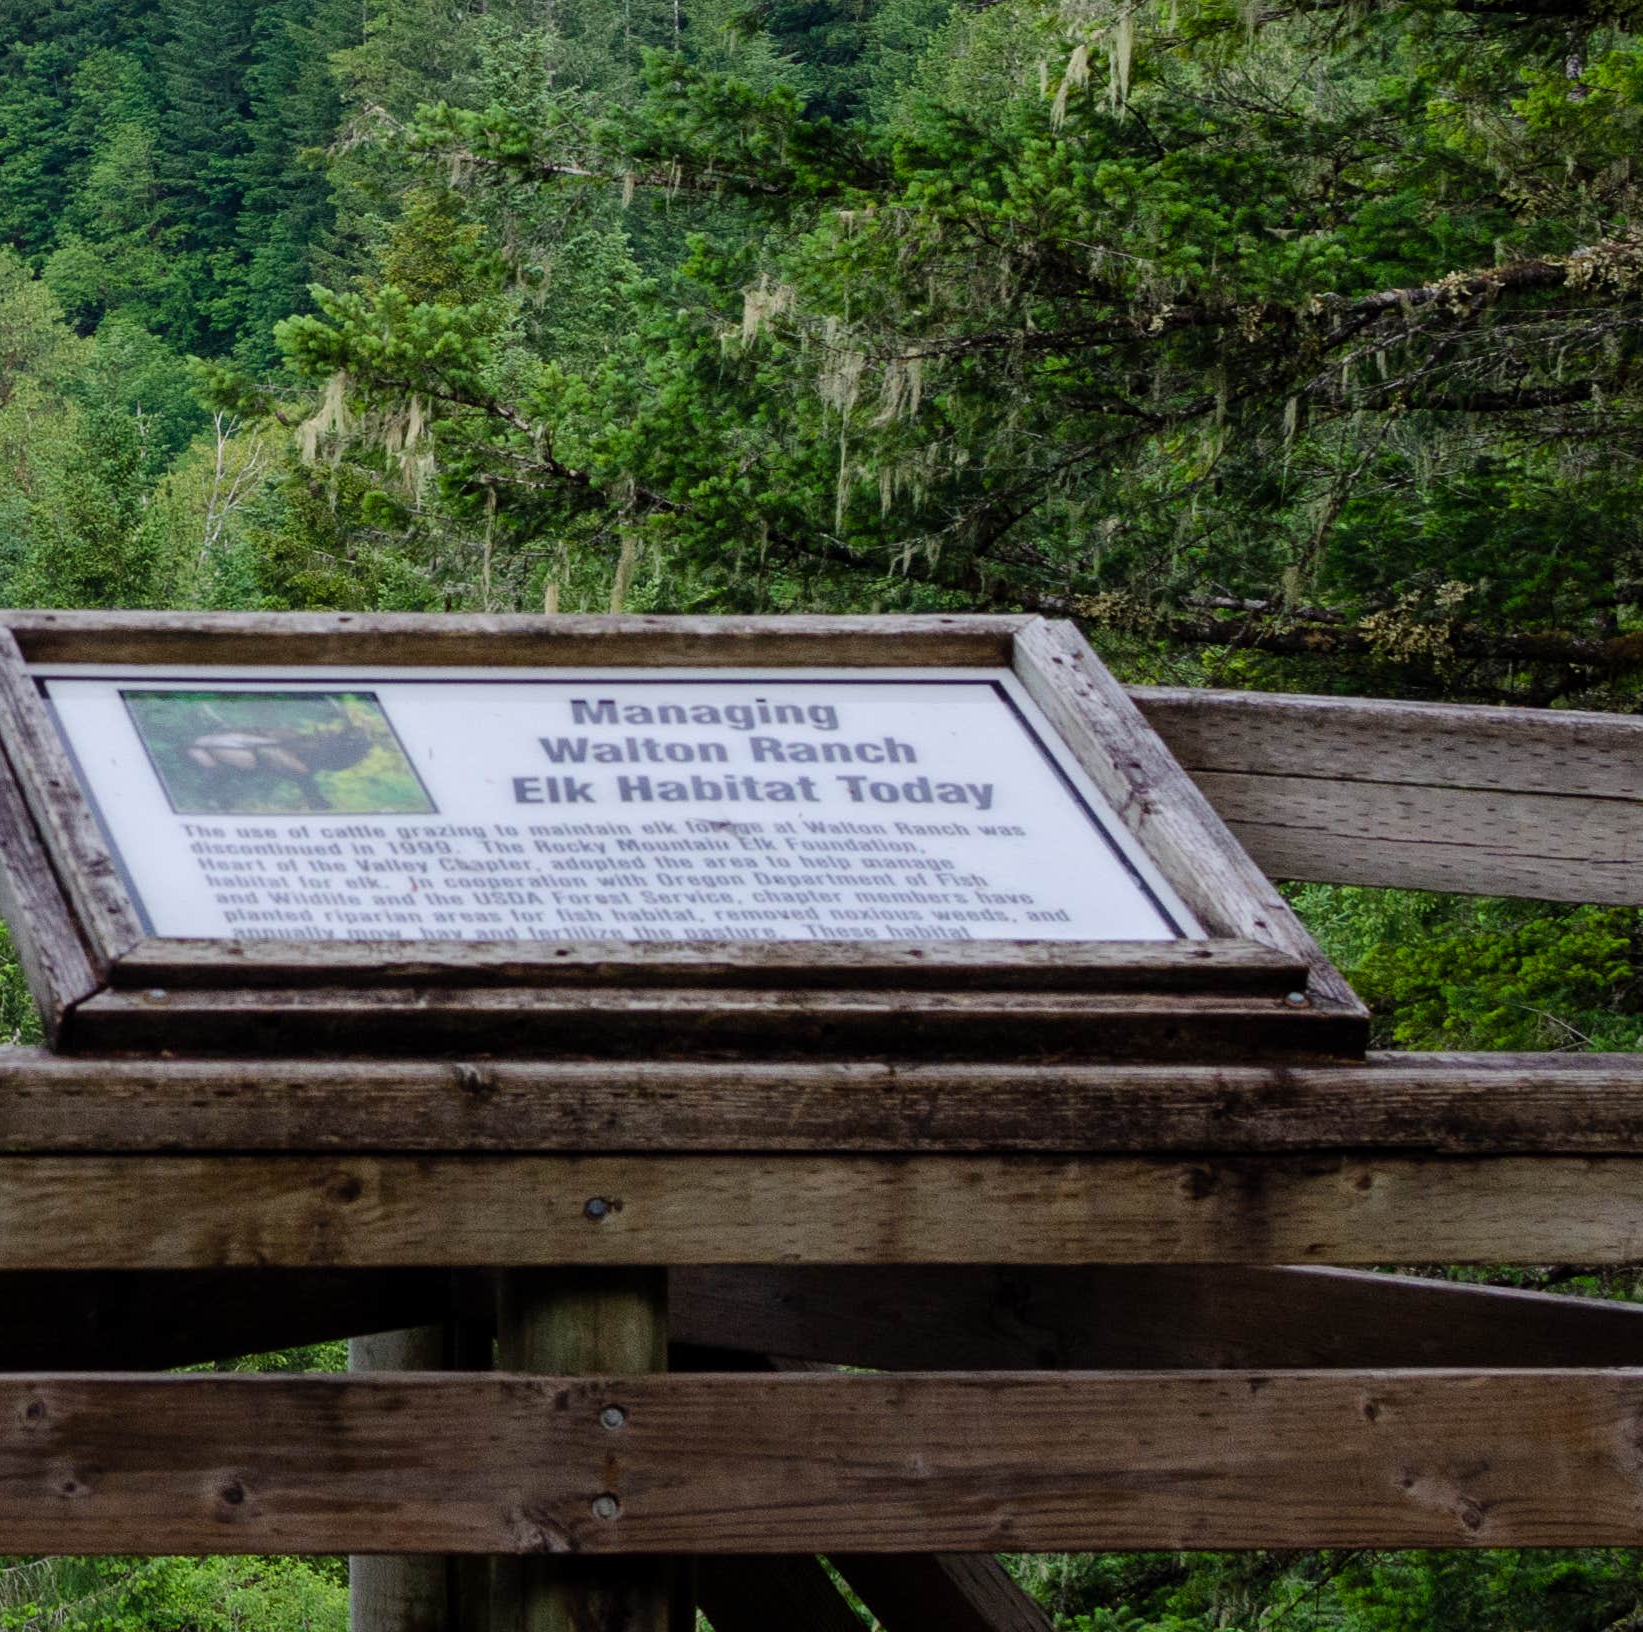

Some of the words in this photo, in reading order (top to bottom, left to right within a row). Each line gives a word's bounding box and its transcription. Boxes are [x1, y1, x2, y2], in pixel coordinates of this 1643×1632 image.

[569, 698, 840, 731] Managing
[537, 736, 729, 764] Walton
[749, 736, 918, 765] Ranch
[512, 776, 597, 804] Elk
[616, 774, 821, 804] Habitat
[834, 775, 995, 811] Today
[182, 824, 226, 839] The
[236, 827, 277, 839] use
[288, 825, 309, 839] of
[320, 824, 386, 838] cattle
[396, 824, 486, 839] grazing
[495, 823, 517, 837] to
[529, 821, 632, 836] maintain
[642, 821, 677, 835] elk
[775, 821, 795, 835] at
[805, 821, 887, 835] Walton
[893, 822, 970, 836] Ranch
[978, 825, 1027, 836] was
[190, 842, 343, 856] discontinued
[351, 843, 375, 856] in
[387, 841, 462, 856] 1999.
[481, 840, 524, 854] The
[534, 840, 607, 855] Rocky
[616, 838, 730, 853] Mountain
[739, 837, 776, 851] Elk
[784, 837, 926, 854] Foundation,
[197, 857, 266, 871] Heart
[276, 858, 299, 871] of
[307, 858, 347, 871] the
[355, 858, 429, 873] Valley
[551, 856, 646, 872] adopted
[654, 855, 693, 869] the
[705, 858, 759, 869] area
[766, 855, 790, 868] to
[798, 855, 852, 870] help
[861, 857, 955, 871] manage
[205, 875, 291, 889] habitat
[299, 875, 332, 889] for
[345, 875, 390, 889] elk.
[408, 875, 433, 888] In
[444, 873, 587, 890] cooperation
[597, 872, 648, 887] with
[656, 872, 745, 888] Oregon
[754, 872, 896, 888] Department
[905, 872, 928, 886] of
[937, 873, 989, 887] Fish
[215, 891, 259, 905] and
[267, 891, 362, 905] Wildlife
[372, 891, 415, 906] and
[424, 892, 464, 905] the
[472, 891, 545, 905] USDA
[551, 891, 635, 905] Forest
[641, 890, 742, 905] Service,
[751, 890, 843, 905] chapter
[855, 890, 969, 904] members
[976, 890, 1034, 904] have
[223, 908, 315, 924] planted
[323, 909, 422, 924] riparian
[431, 911, 501, 923] areas
[509, 908, 545, 922] for
[555, 908, 603, 922] fish
[610, 908, 705, 924] habitat,
[714, 907, 820, 921] removed
[829, 907, 923, 921] noxious
[931, 908, 1018, 923] weeds,
[1026, 908, 1073, 922] and
[801, 924, 877, 940] These
[885, 924, 974, 939] habitat
